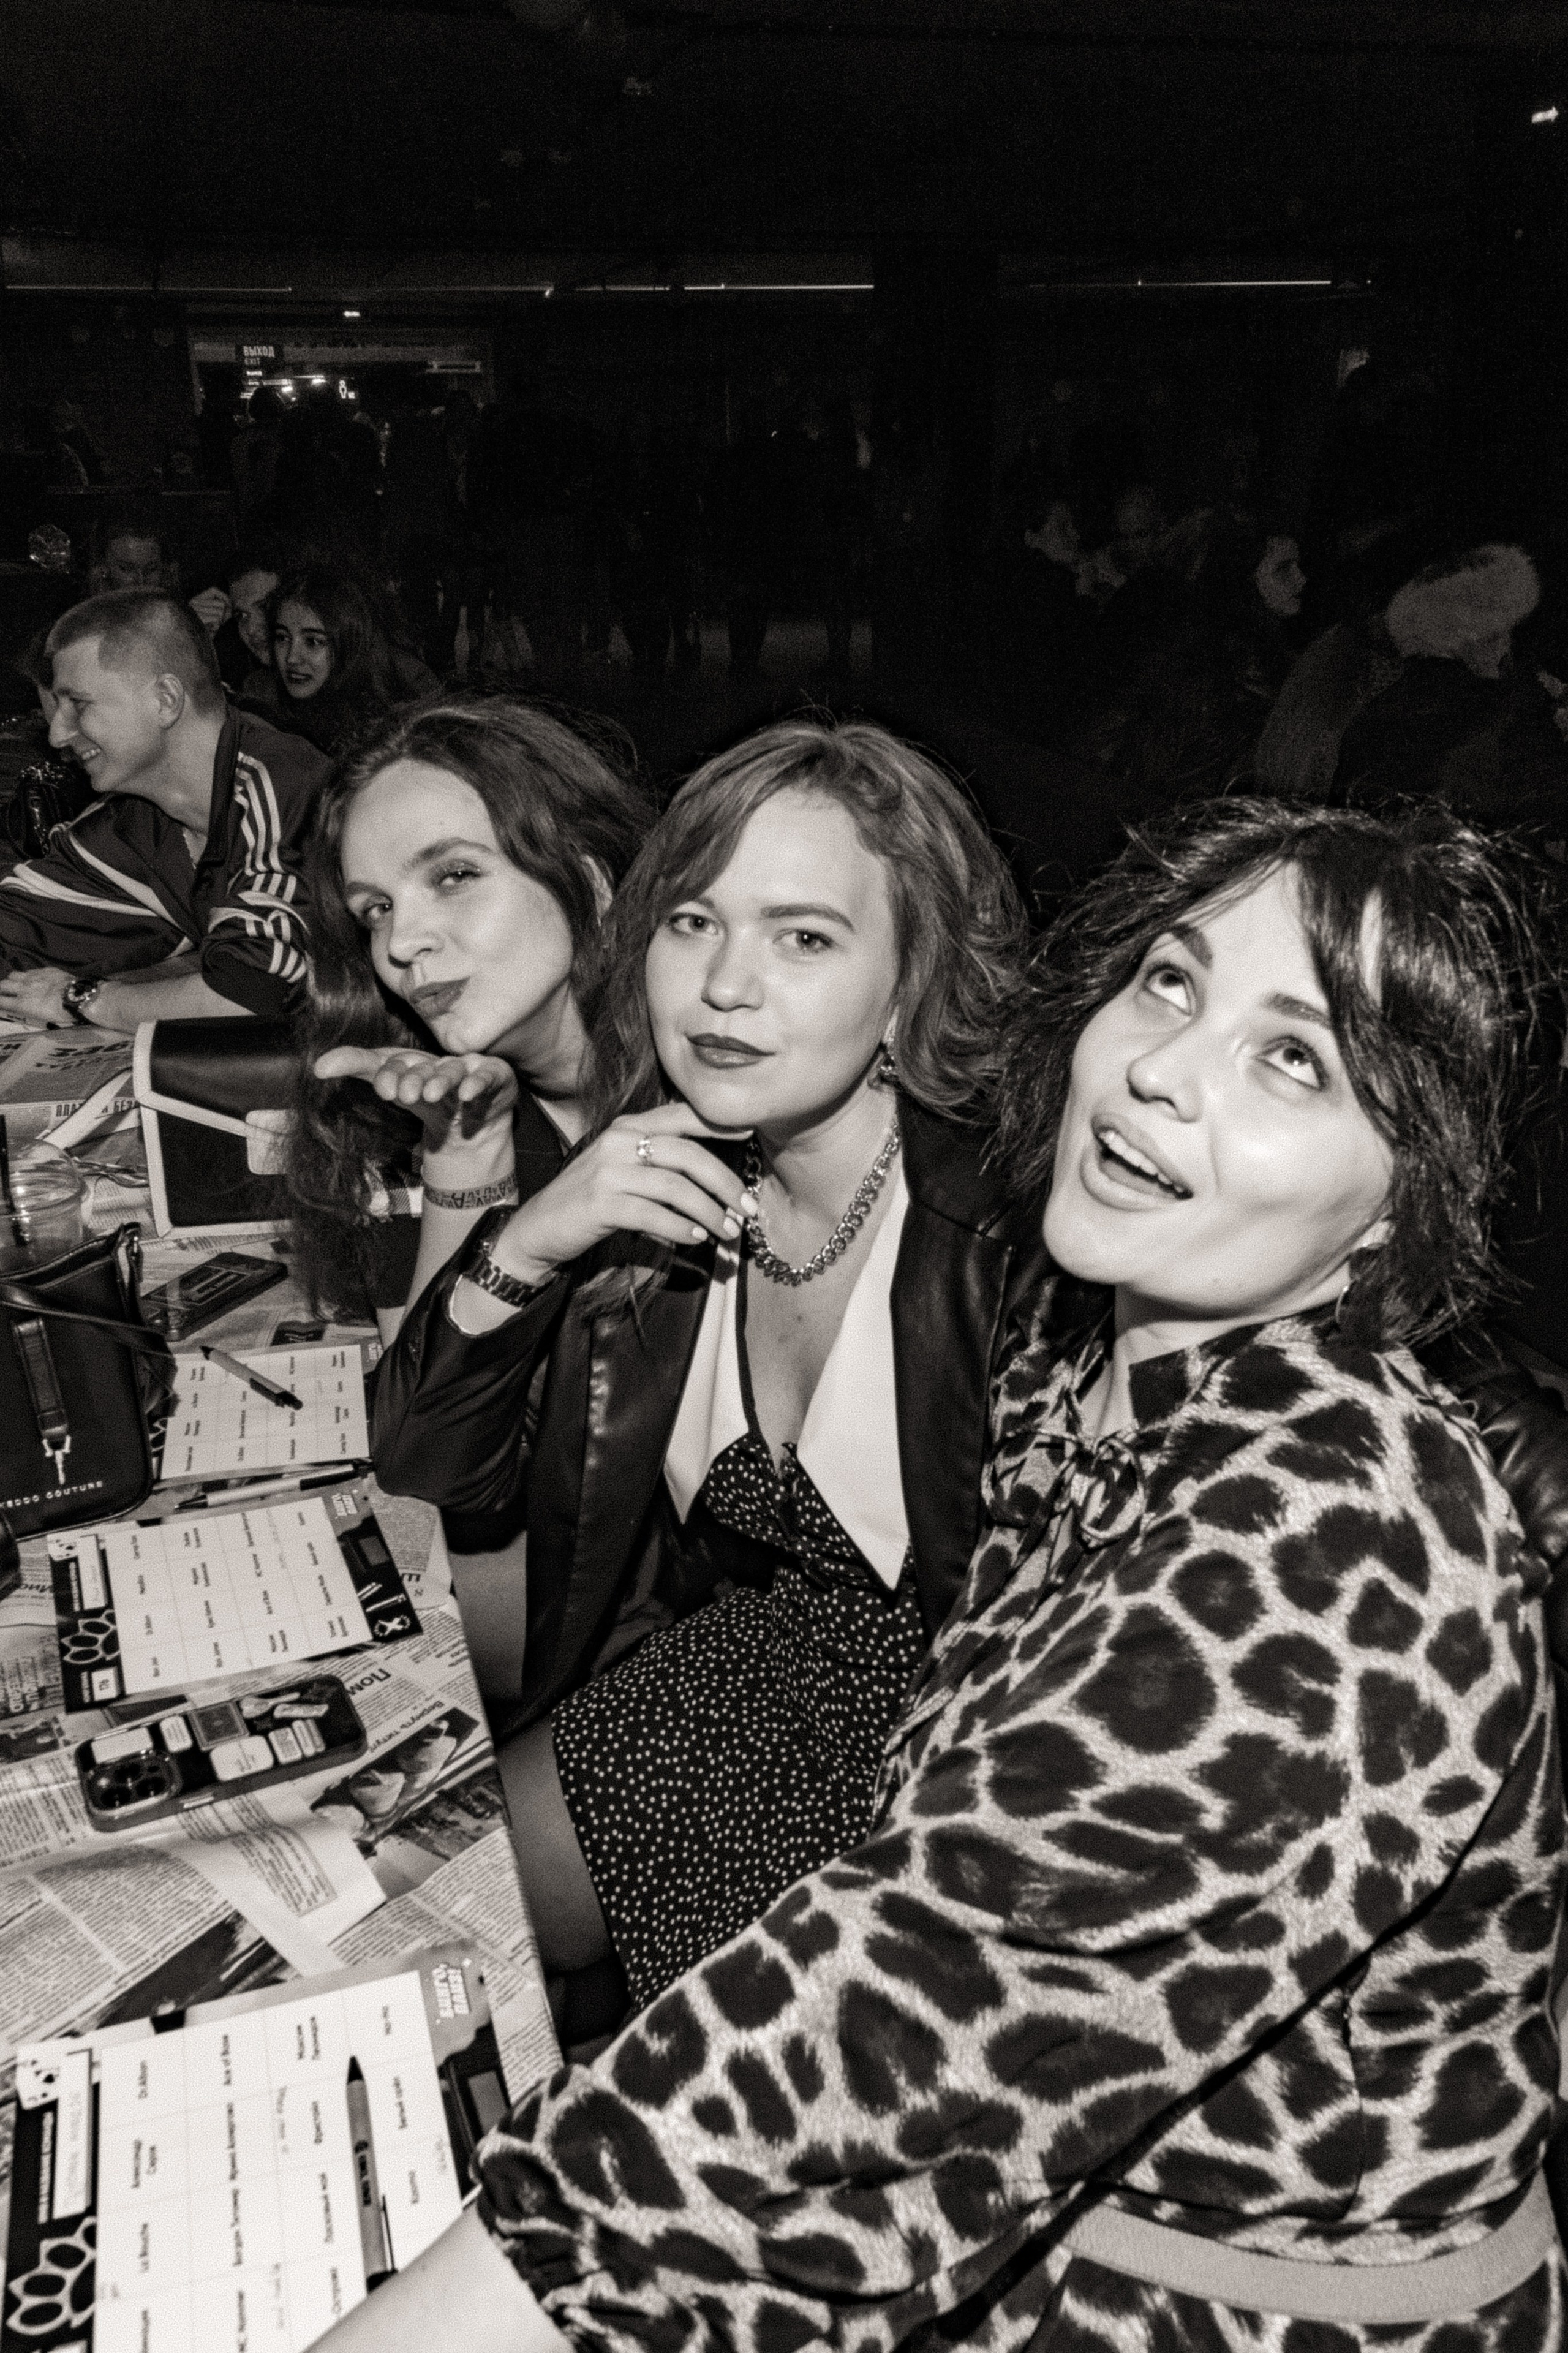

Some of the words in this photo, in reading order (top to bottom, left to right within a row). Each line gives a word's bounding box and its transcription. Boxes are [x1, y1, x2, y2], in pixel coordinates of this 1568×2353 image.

[243, 346, 275, 358] ВЫХОД
[46, 1481, 103, 1499] COUTURE
[432, 1963, 454, 2018] БИНГО,
[447, 1968, 470, 2014] ПЛИЗ!
